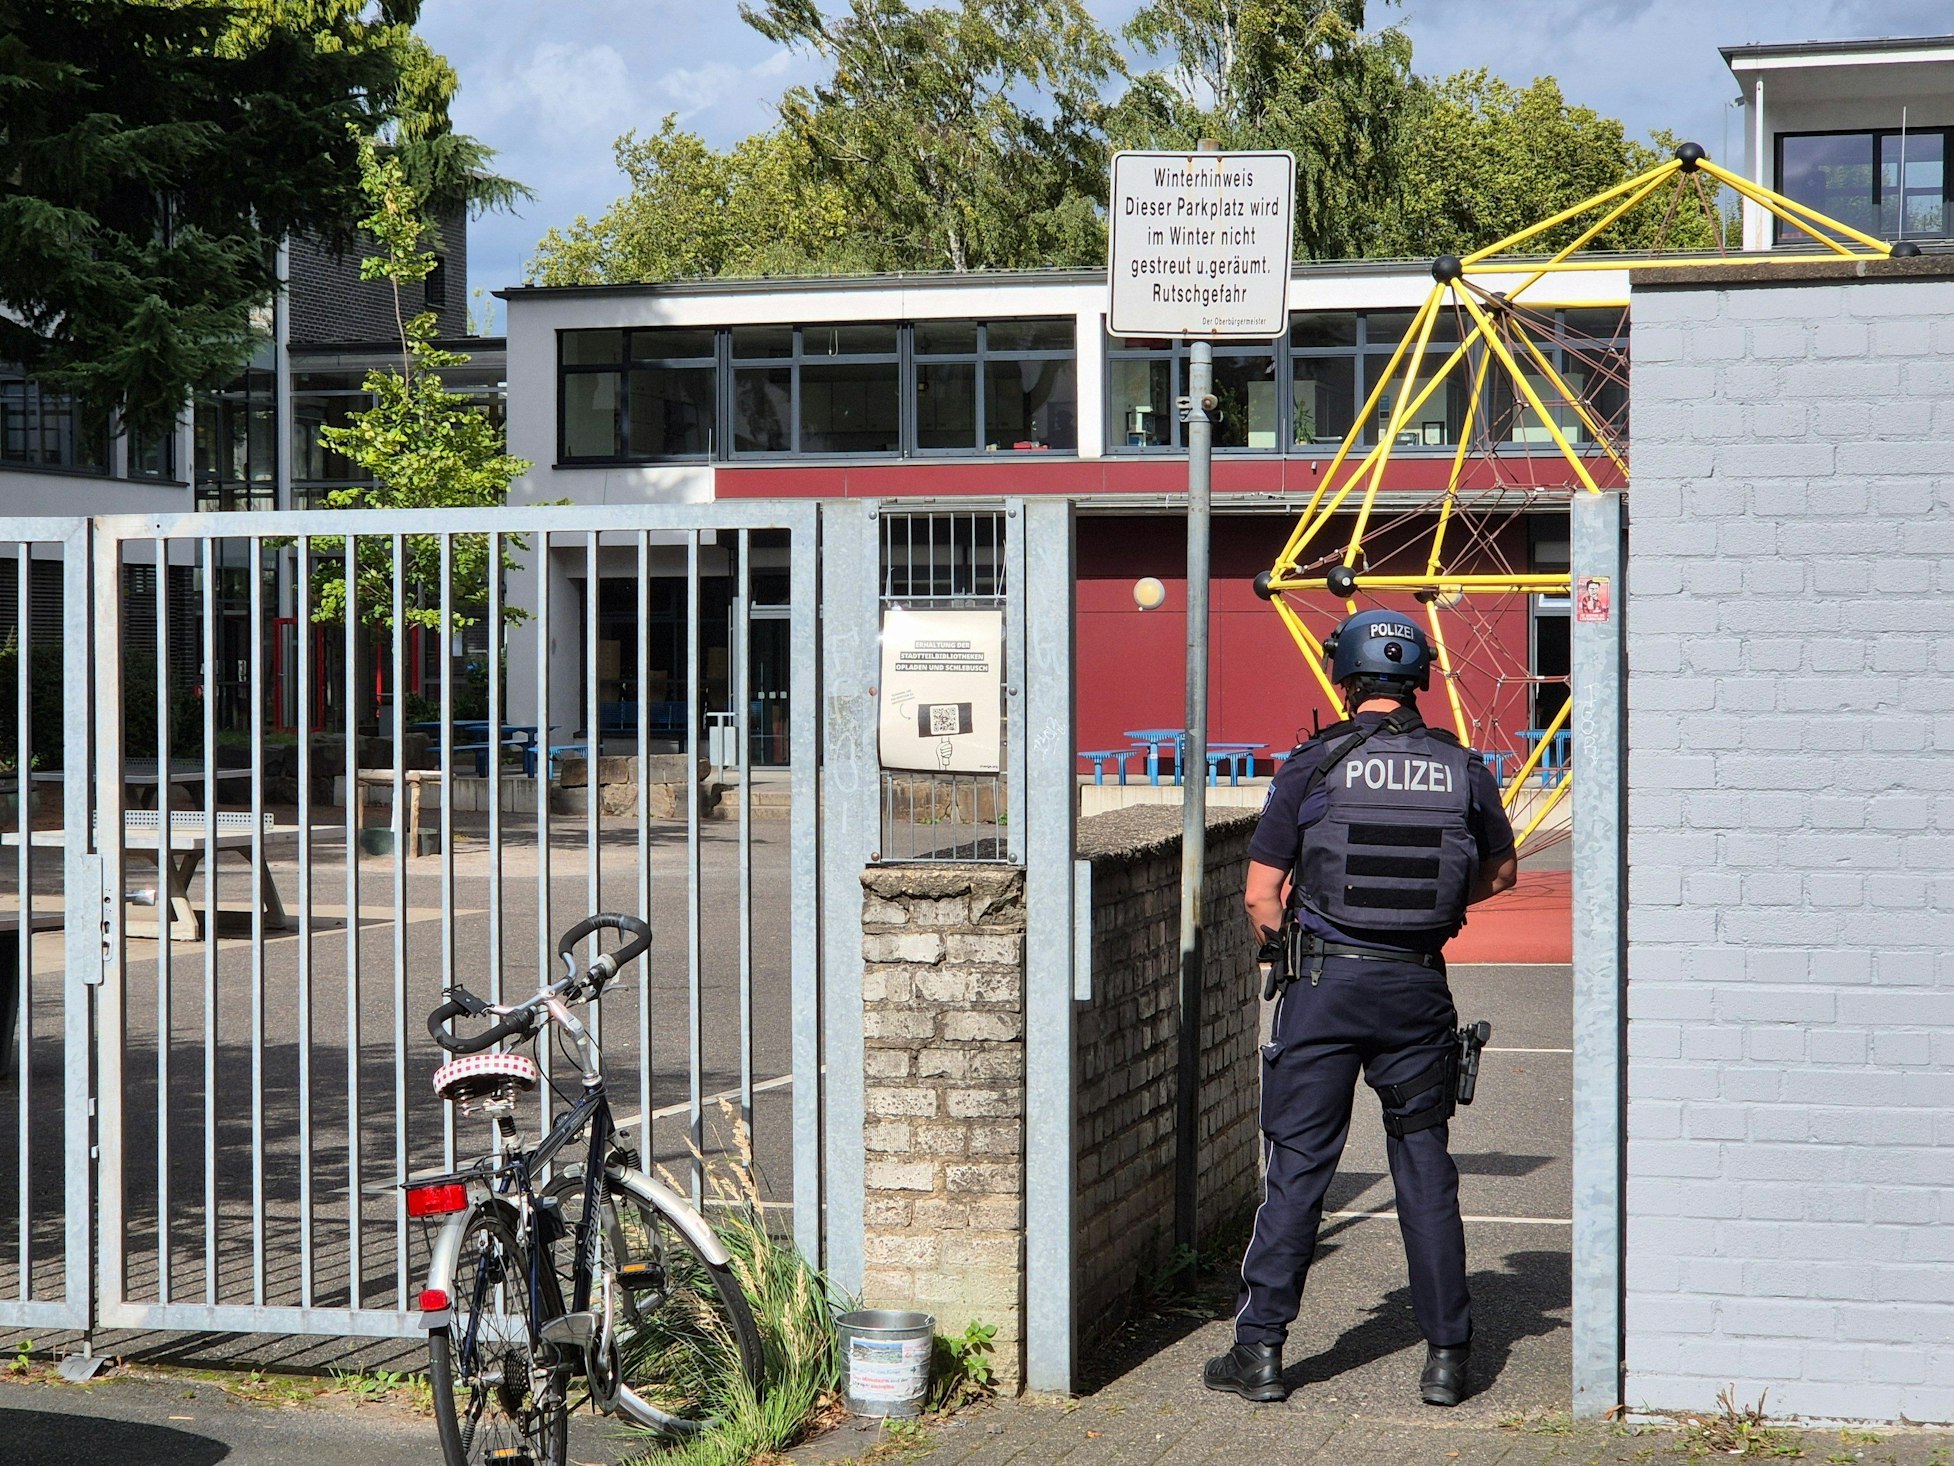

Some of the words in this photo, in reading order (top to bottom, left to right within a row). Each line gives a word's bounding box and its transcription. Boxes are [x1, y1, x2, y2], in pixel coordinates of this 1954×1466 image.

[1154, 168, 1253, 187] Winterhinweis
[1125, 196, 1172, 216] Dieser
[1177, 197, 1244, 220] Parkplatz
[1250, 197, 1279, 216] wird
[1148, 226, 1164, 245] im
[1170, 226, 1215, 245] Winter
[1221, 226, 1256, 245] nicht
[1131, 257, 1191, 278] gestreut
[1153, 283, 1247, 307] Rutschgefahr
[1202, 317, 1213, 325] Der
[1214, 316, 1267, 327] Oberbürgermeister
[1370, 623, 1414, 640] POLIZEI
[915, 641, 956, 649] ERHALTUNG
[956, 641, 970, 649] DER
[900, 652, 984, 660] STADTTEILBIBLIOTHEKEN
[896, 663, 928, 671] OPLADEN
[928, 663, 945, 671] UND
[945, 664, 988, 672] SCHLEBUSCH
[1346, 759, 1453, 793] POLIZEI
